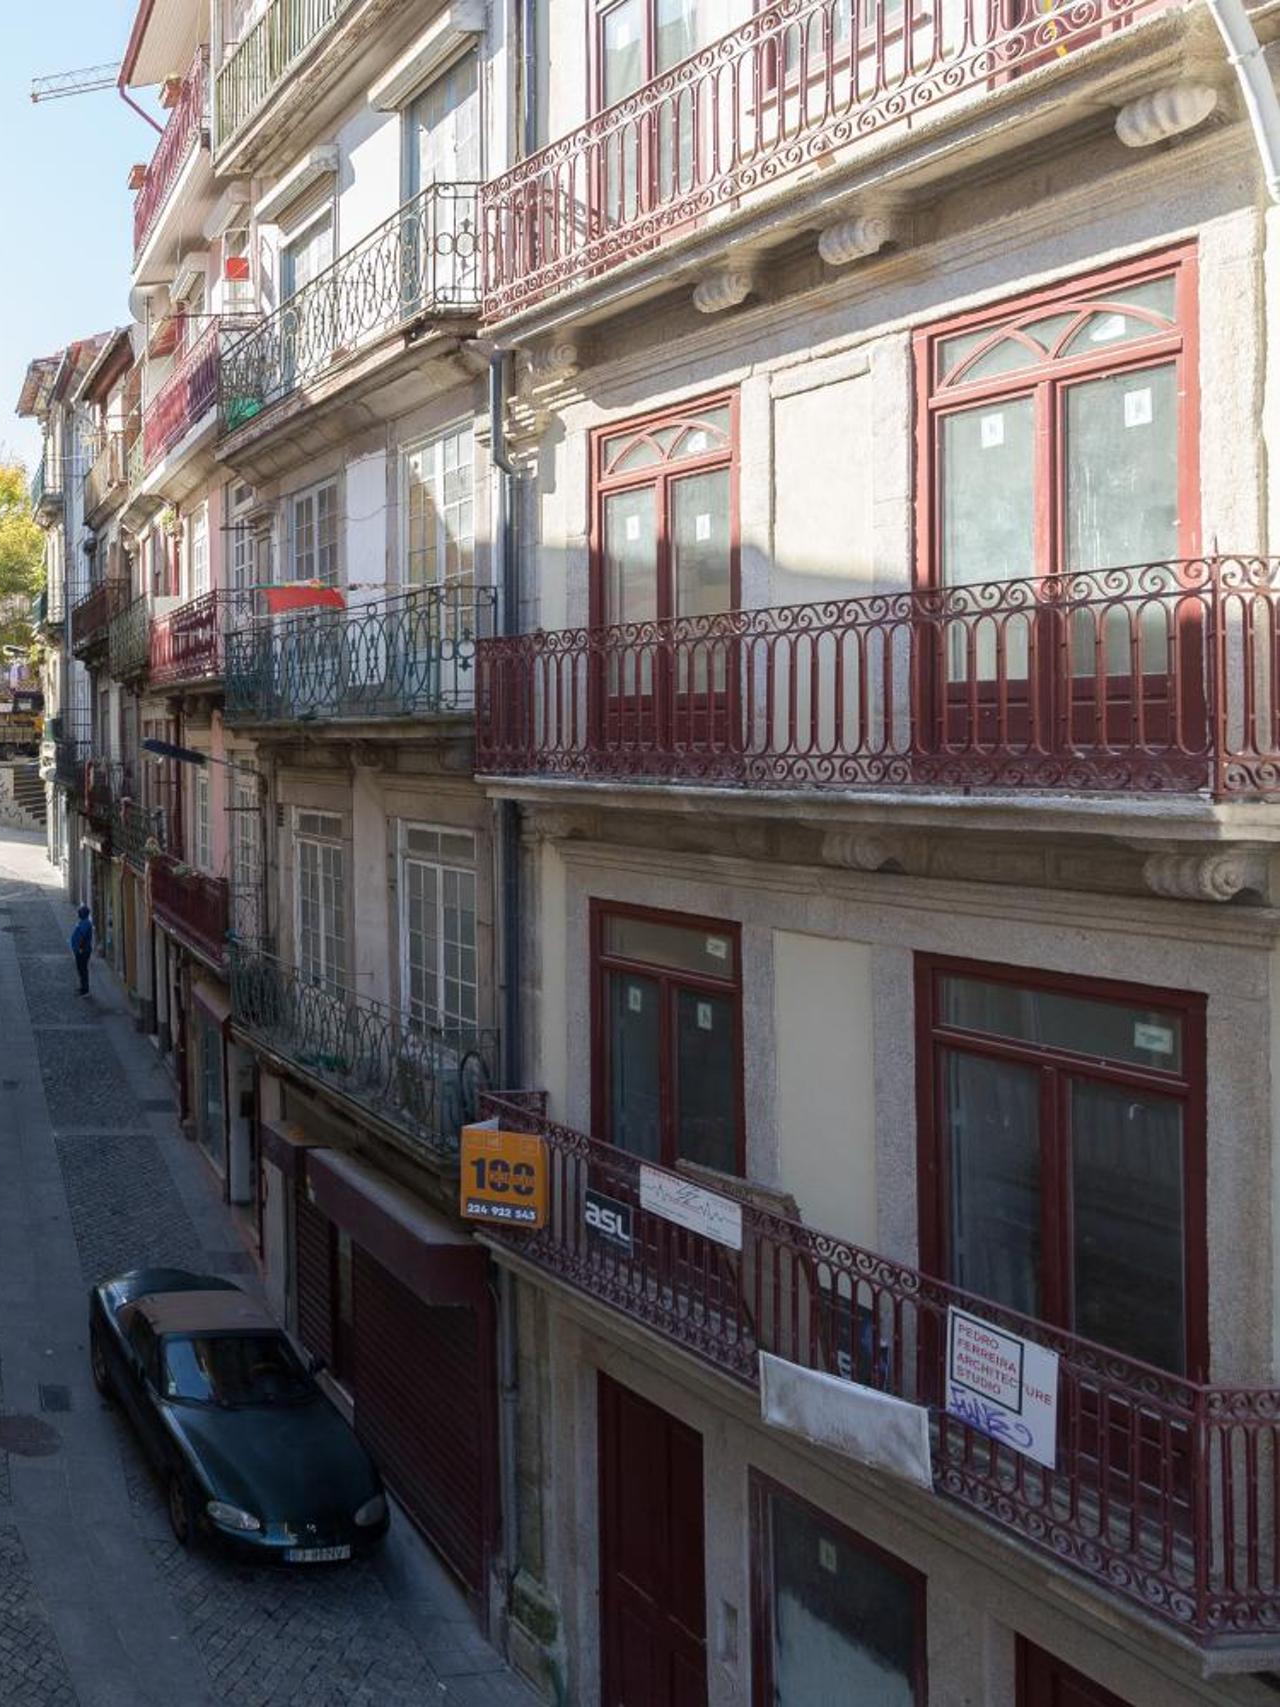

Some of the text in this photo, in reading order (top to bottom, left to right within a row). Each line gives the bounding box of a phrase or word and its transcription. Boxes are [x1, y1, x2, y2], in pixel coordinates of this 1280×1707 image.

[467, 1203, 488, 1214] 224
[490, 1206, 512, 1217] 922
[958, 1323, 999, 1349] PEDRO
[957, 1338, 1017, 1373] FERREIRA
[957, 1366, 1001, 1395] STUDIO
